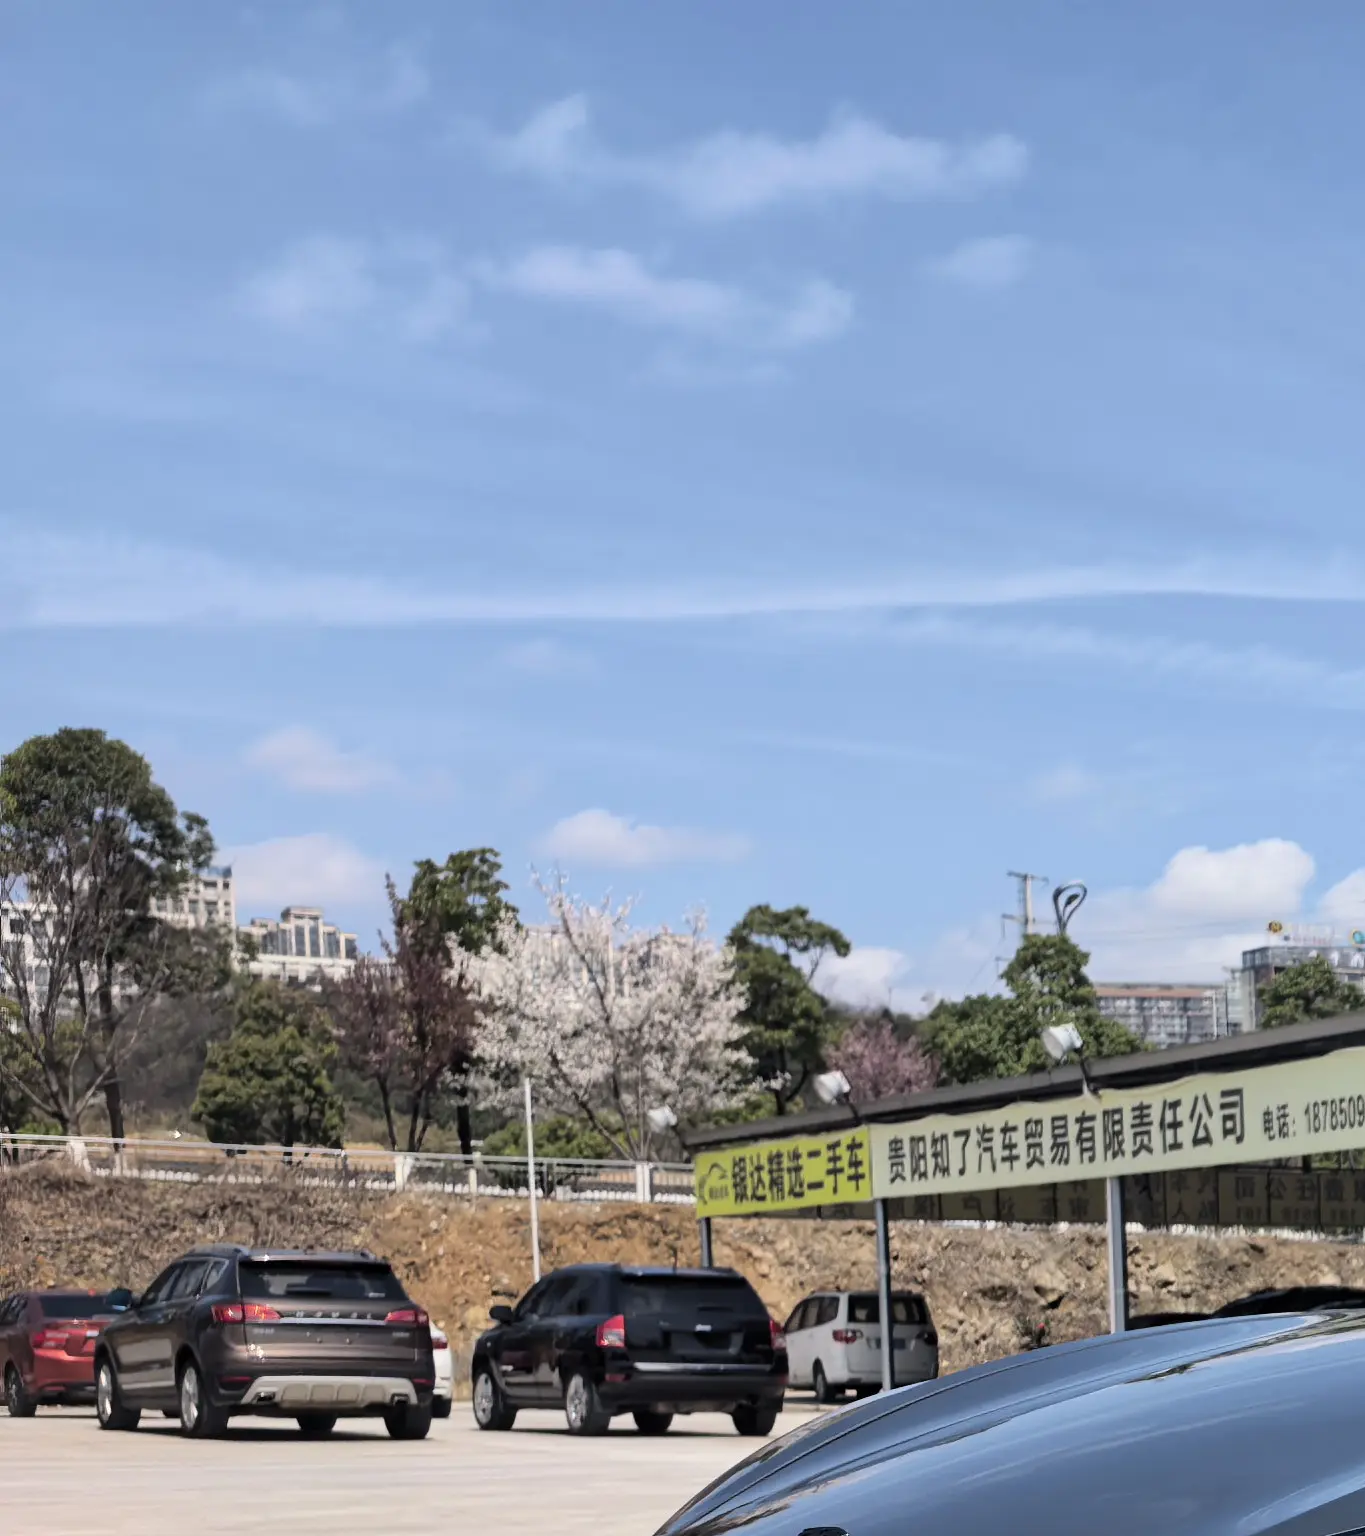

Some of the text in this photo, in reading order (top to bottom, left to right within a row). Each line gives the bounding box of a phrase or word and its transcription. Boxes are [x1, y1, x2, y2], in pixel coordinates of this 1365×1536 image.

[732, 1135, 866, 1205] 银达精选二手车
[887, 1087, 1246, 1185] 贵阳知了汽车贸易有限责任公司
